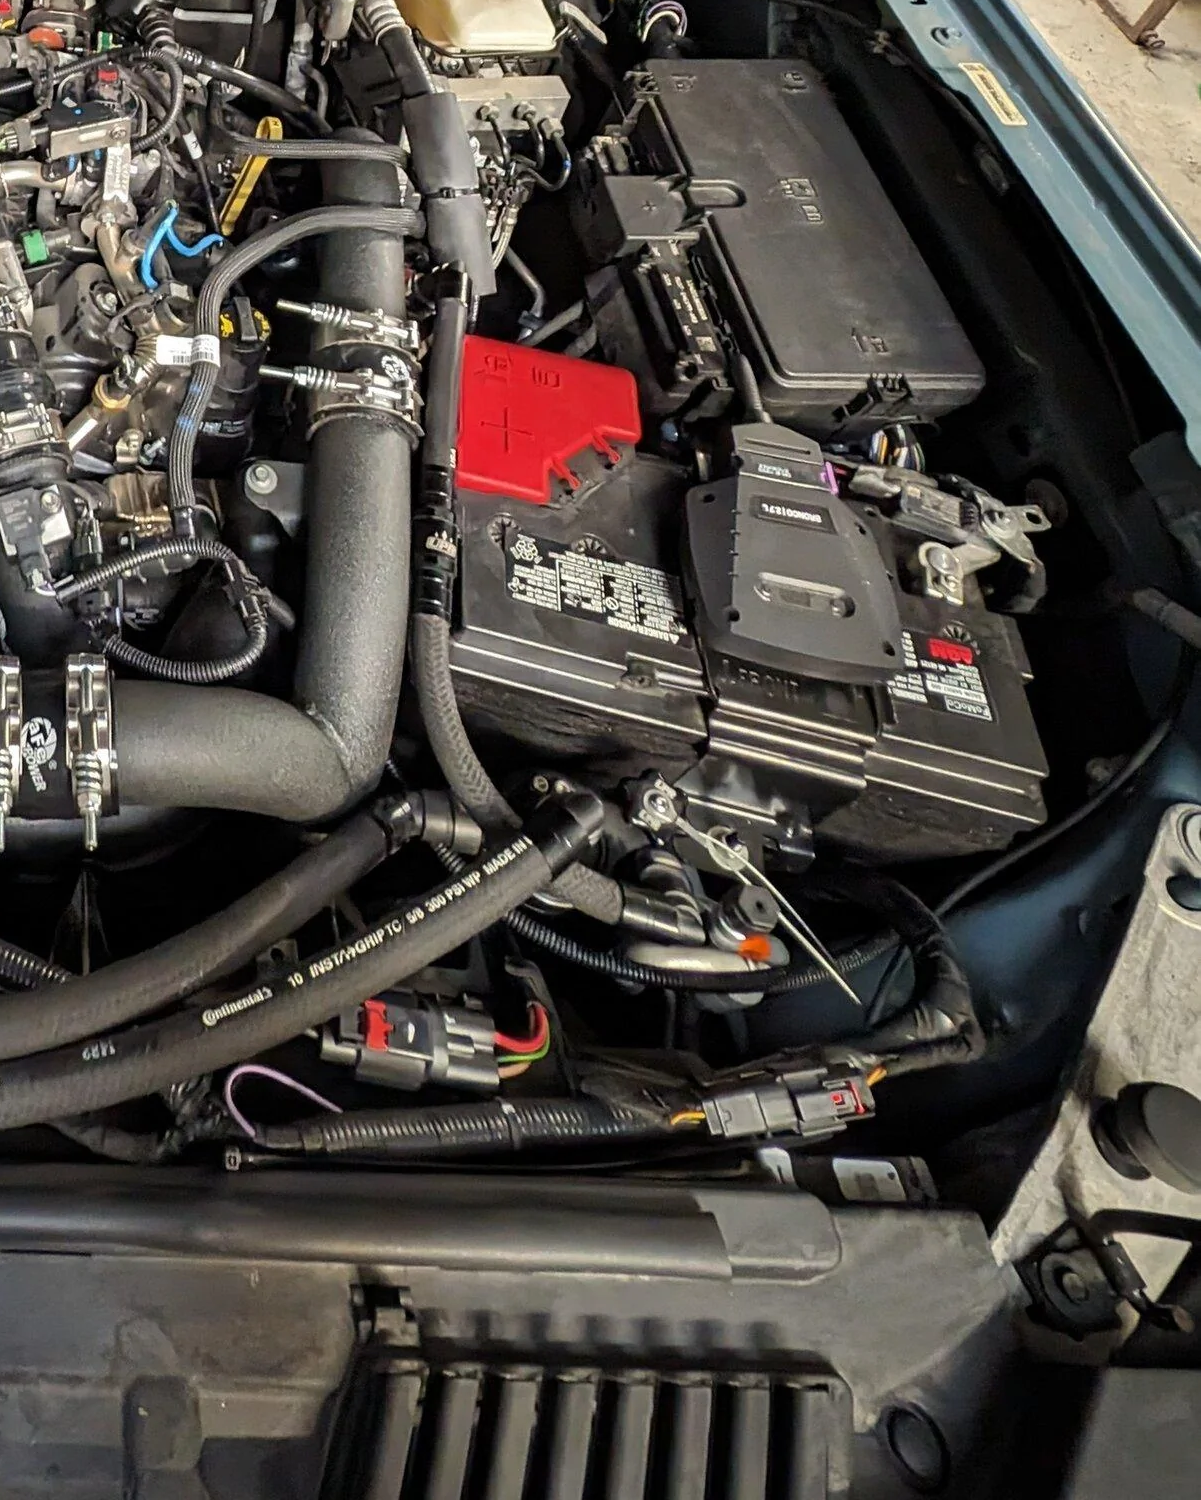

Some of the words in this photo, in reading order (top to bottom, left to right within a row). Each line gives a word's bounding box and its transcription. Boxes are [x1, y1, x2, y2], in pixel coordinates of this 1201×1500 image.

[948, 699, 990, 716] FoMoCo
[288, 972, 304, 987] 10
[385, 919, 402, 936] TC
[405, 906, 425, 925] 5/8
[425, 893, 447, 913] 300
[445, 883, 466, 901] PSI
[463, 871, 482, 888] WP
[482, 849, 517, 875] MADE
[512, 837, 528, 855] IN
